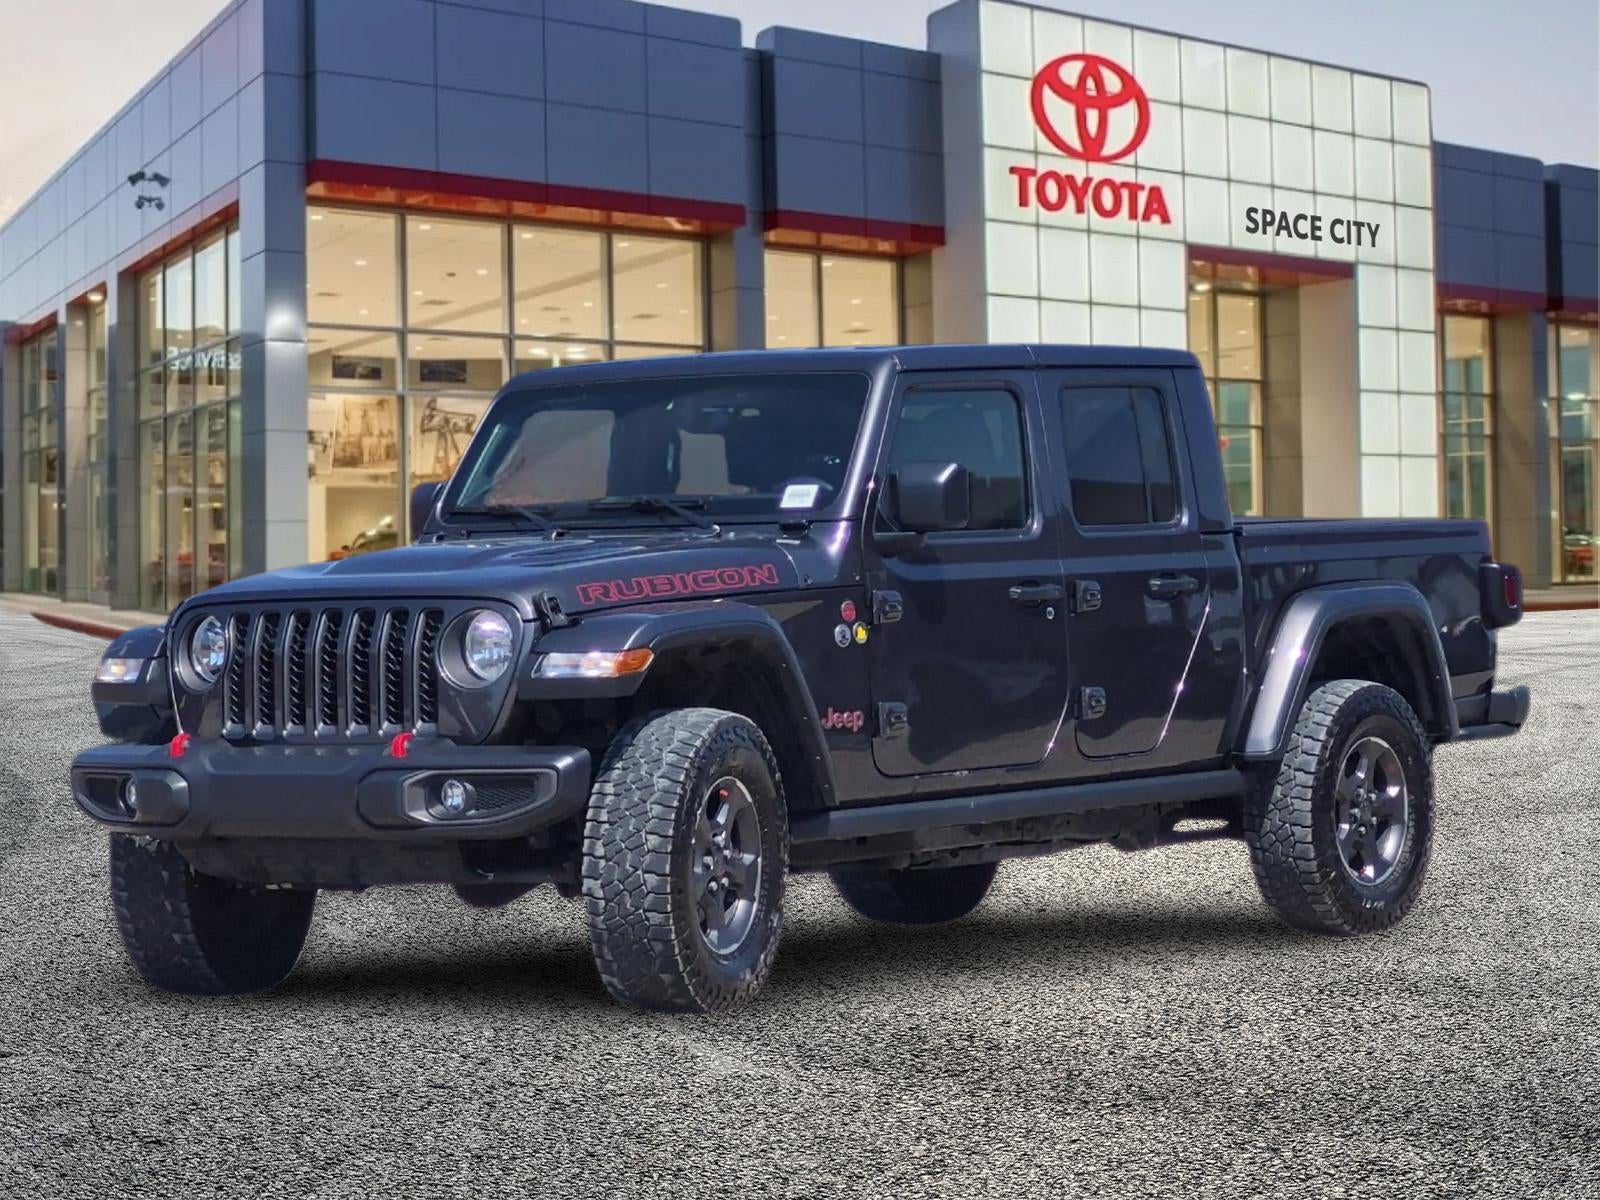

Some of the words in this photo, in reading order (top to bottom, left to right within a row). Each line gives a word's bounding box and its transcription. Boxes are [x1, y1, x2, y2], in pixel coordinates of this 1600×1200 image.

[1009, 166, 1171, 225] TOYOTA
[1245, 207, 1322, 242] SPACE
[1329, 217, 1381, 248] CITY
[576, 564, 779, 605] RUBICON
[821, 707, 864, 732] Jeep
